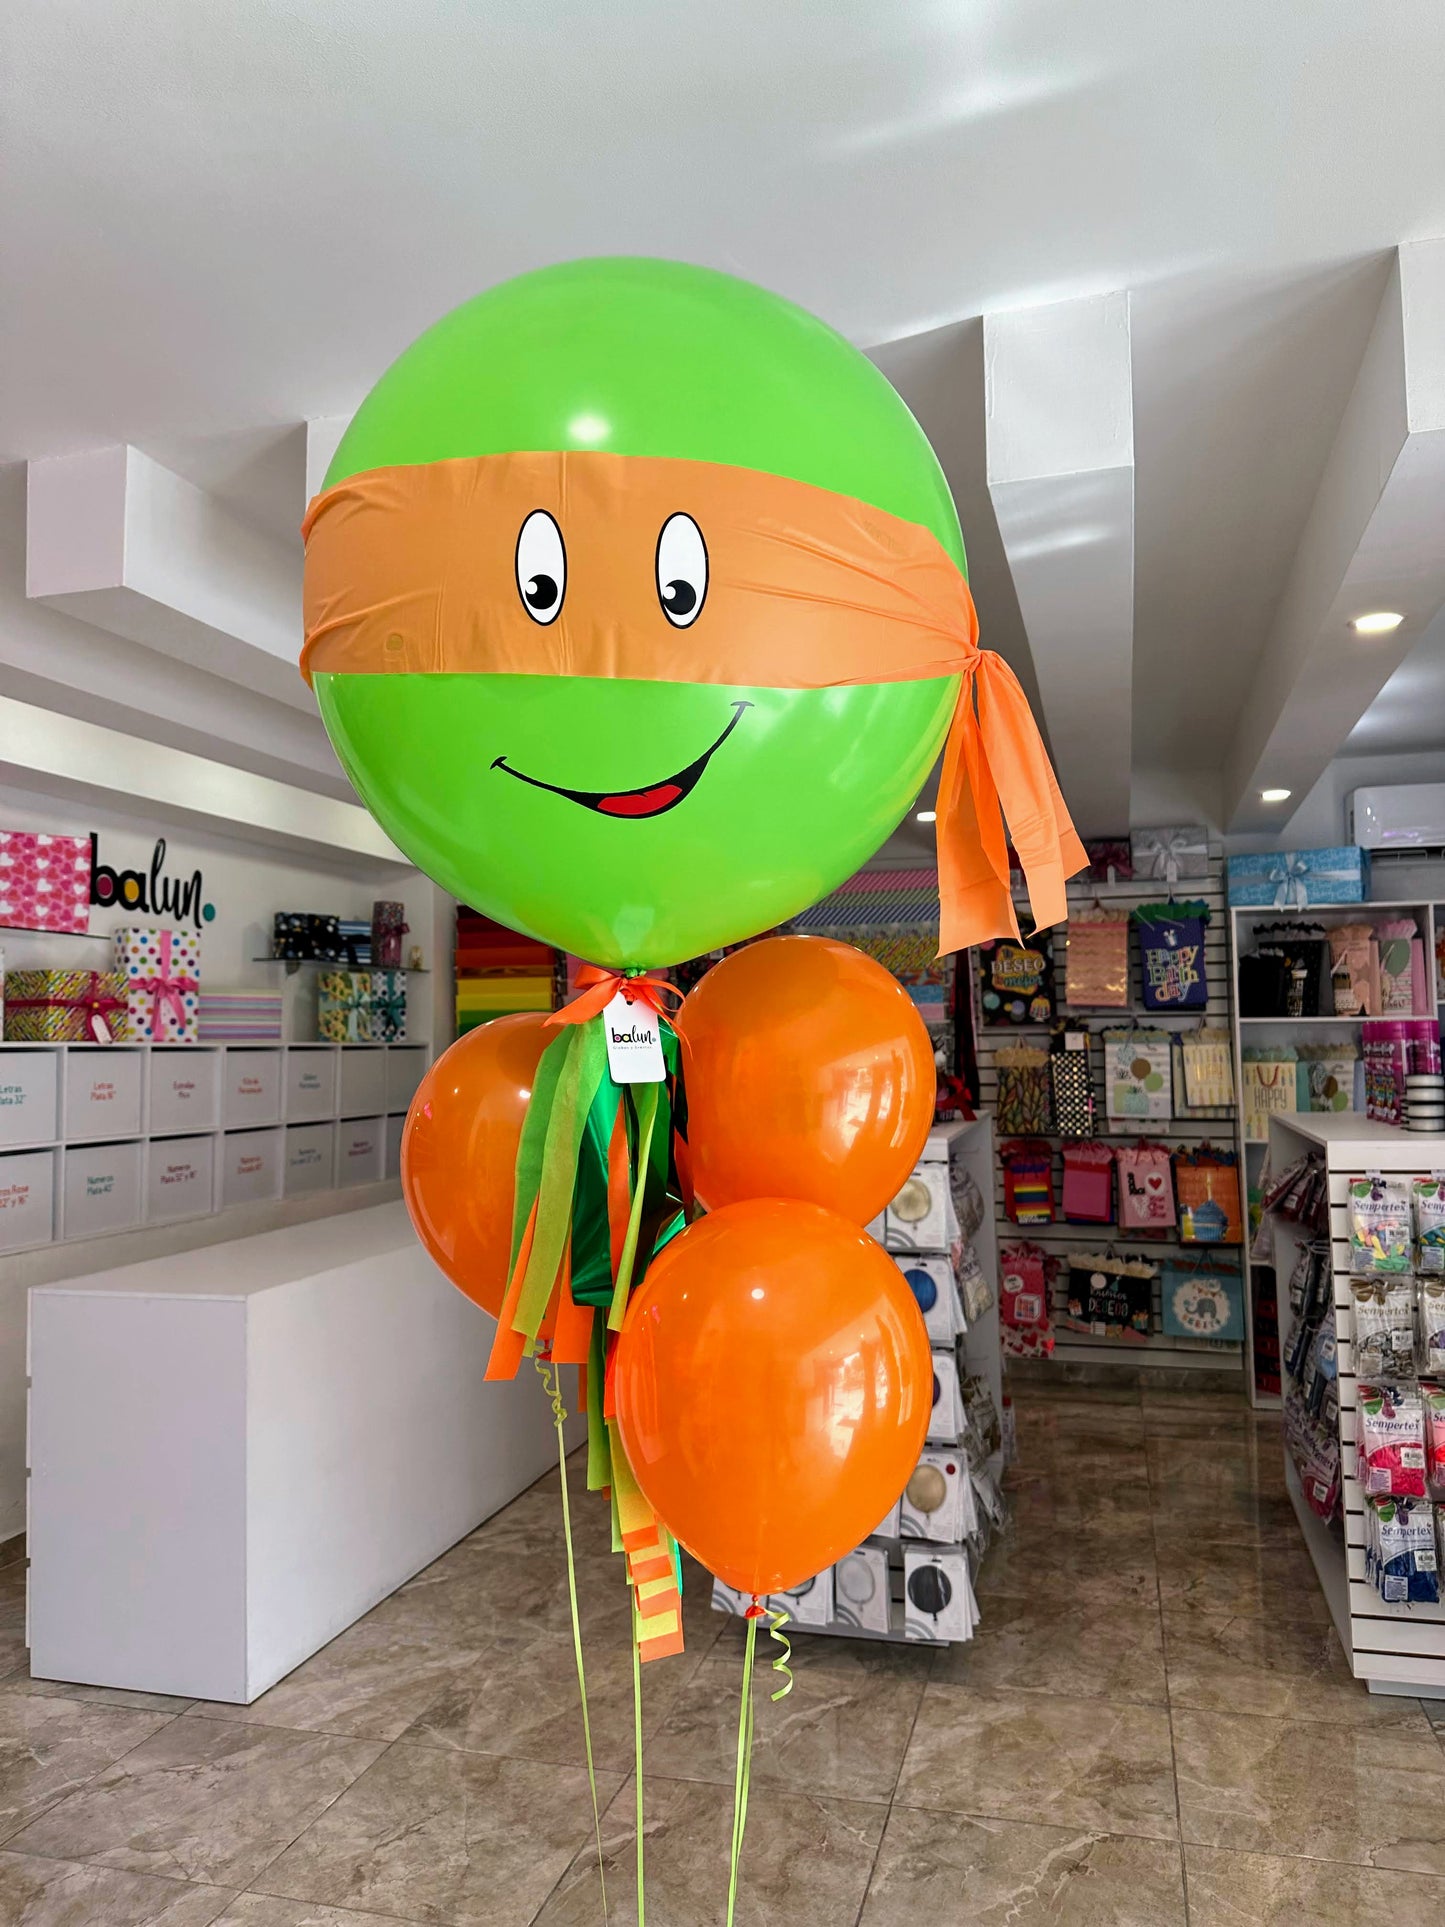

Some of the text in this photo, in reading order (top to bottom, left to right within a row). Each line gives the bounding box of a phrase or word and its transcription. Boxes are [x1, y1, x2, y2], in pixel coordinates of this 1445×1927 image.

[1145, 945, 1199, 967] Happy
[991, 959, 1046, 975] DESEO
[1155, 981, 1191, 1002] day
[1254, 1086, 1287, 1110] HAPPY
[1354, 1200, 1406, 1213] Sempertex
[1365, 1418, 1419, 1432] Sempertex
[1381, 1524, 1433, 1539] Sempertex
